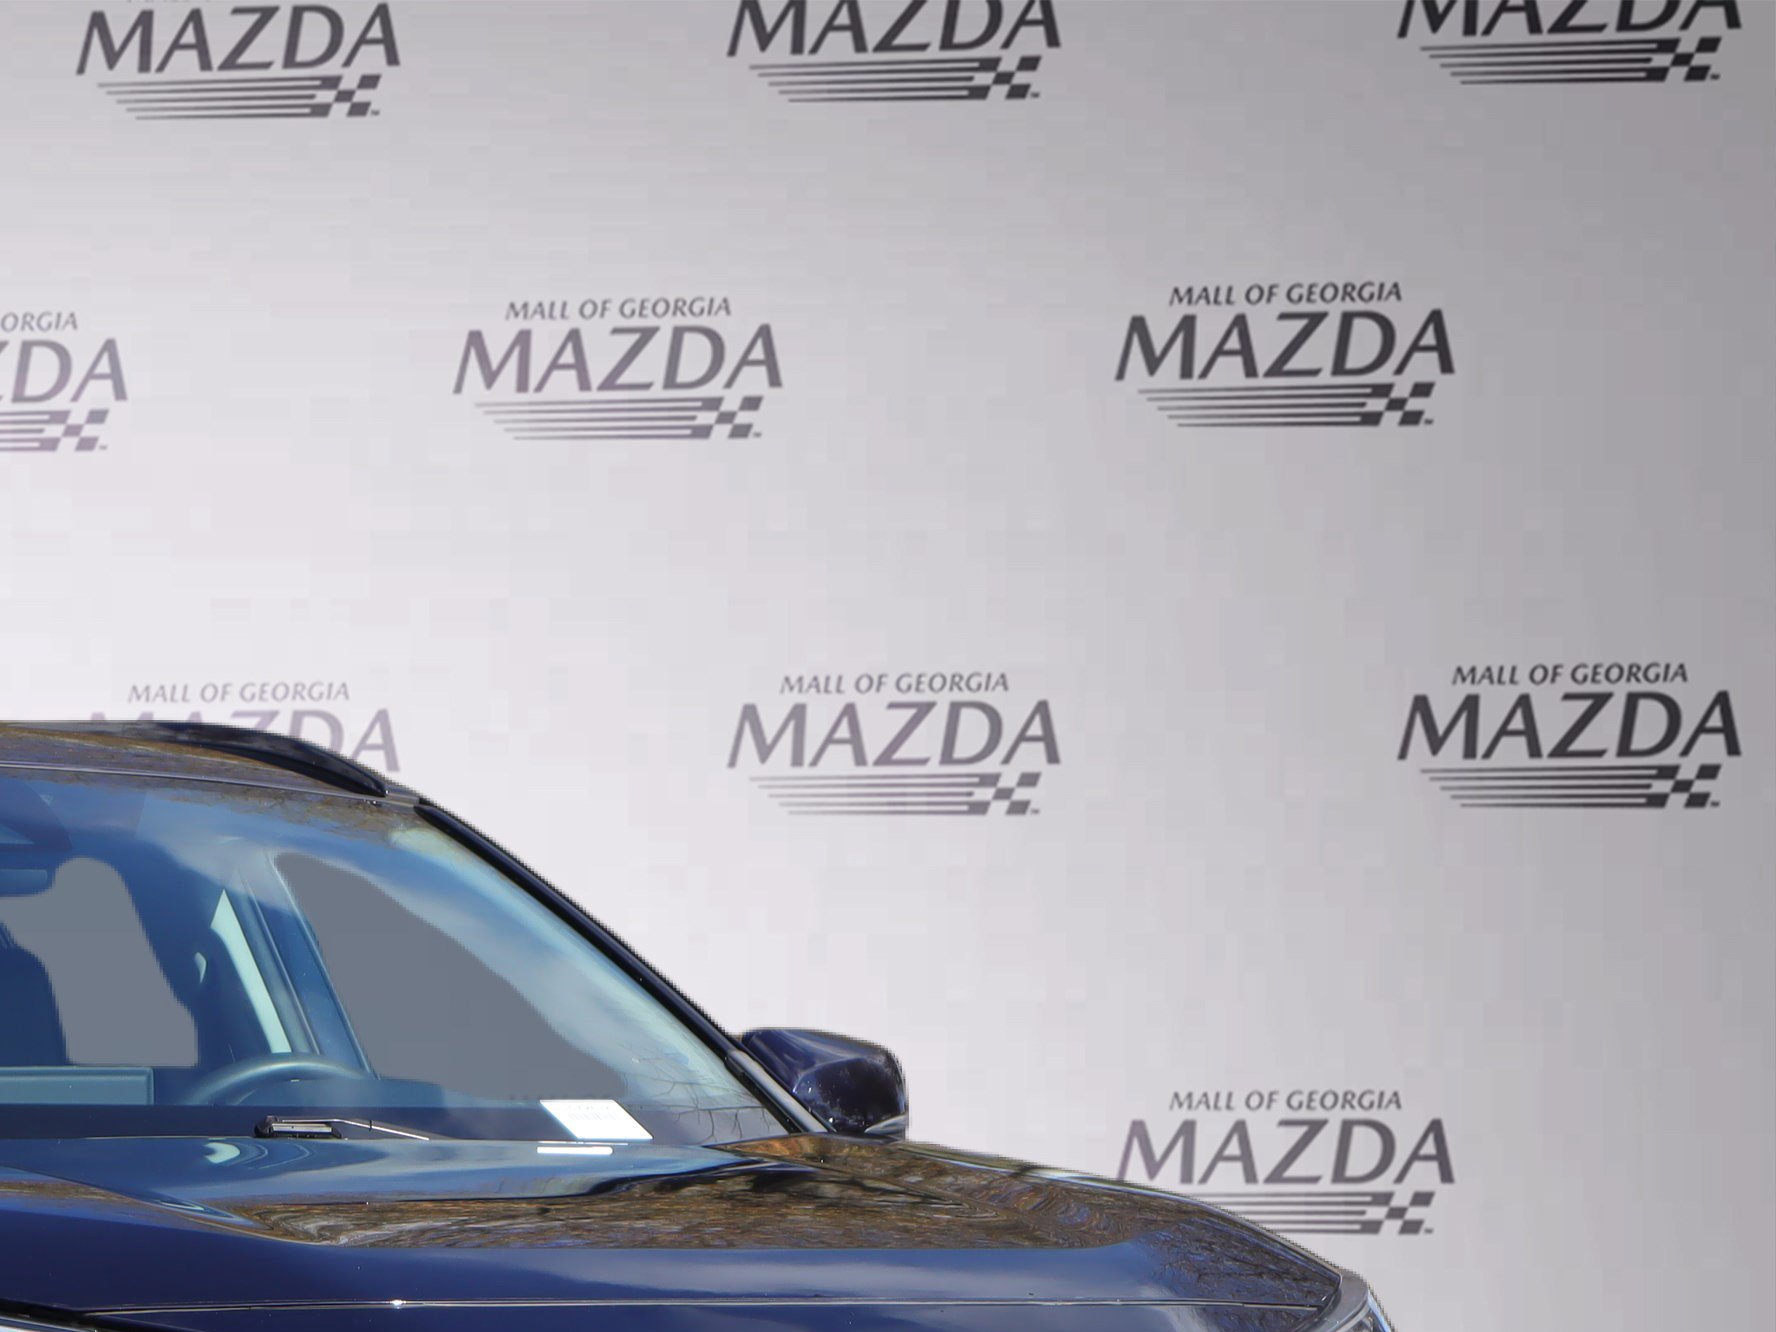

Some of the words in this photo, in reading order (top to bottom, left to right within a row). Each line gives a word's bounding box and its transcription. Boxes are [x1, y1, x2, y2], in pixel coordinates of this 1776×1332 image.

[76, 2, 401, 75] MAZDA
[727, 0, 1061, 57] MAZDA
[505, 300, 569, 321] MALL
[579, 298, 612, 321] OF
[618, 296, 731, 320] GEORGIA
[1169, 285, 1235, 306] MALL
[1245, 284, 1279, 306] OF
[1286, 281, 1402, 305] GEORGIA
[453, 323, 783, 395] MAZDA
[1115, 308, 1455, 381] MAZDA
[127, 683, 190, 704] MALL
[199, 682, 233, 704] OF
[239, 681, 350, 703] GEORGIA
[780, 674, 844, 695] MALL
[854, 673, 888, 695] OF
[895, 672, 1009, 695] GEORGIA
[1452, 665, 1518, 686] MALL
[1528, 663, 1563, 686] OF
[1570, 661, 1688, 686] GEORGIA
[727, 699, 1061, 768] MAZDA
[1397, 689, 1742, 760] MAZDA
[1169, 1091, 1235, 1112] MALL
[1245, 1090, 1279, 1112] OF
[1286, 1088, 1402, 1112] GEORGIA
[1115, 1117, 1455, 1185] MAZDA
